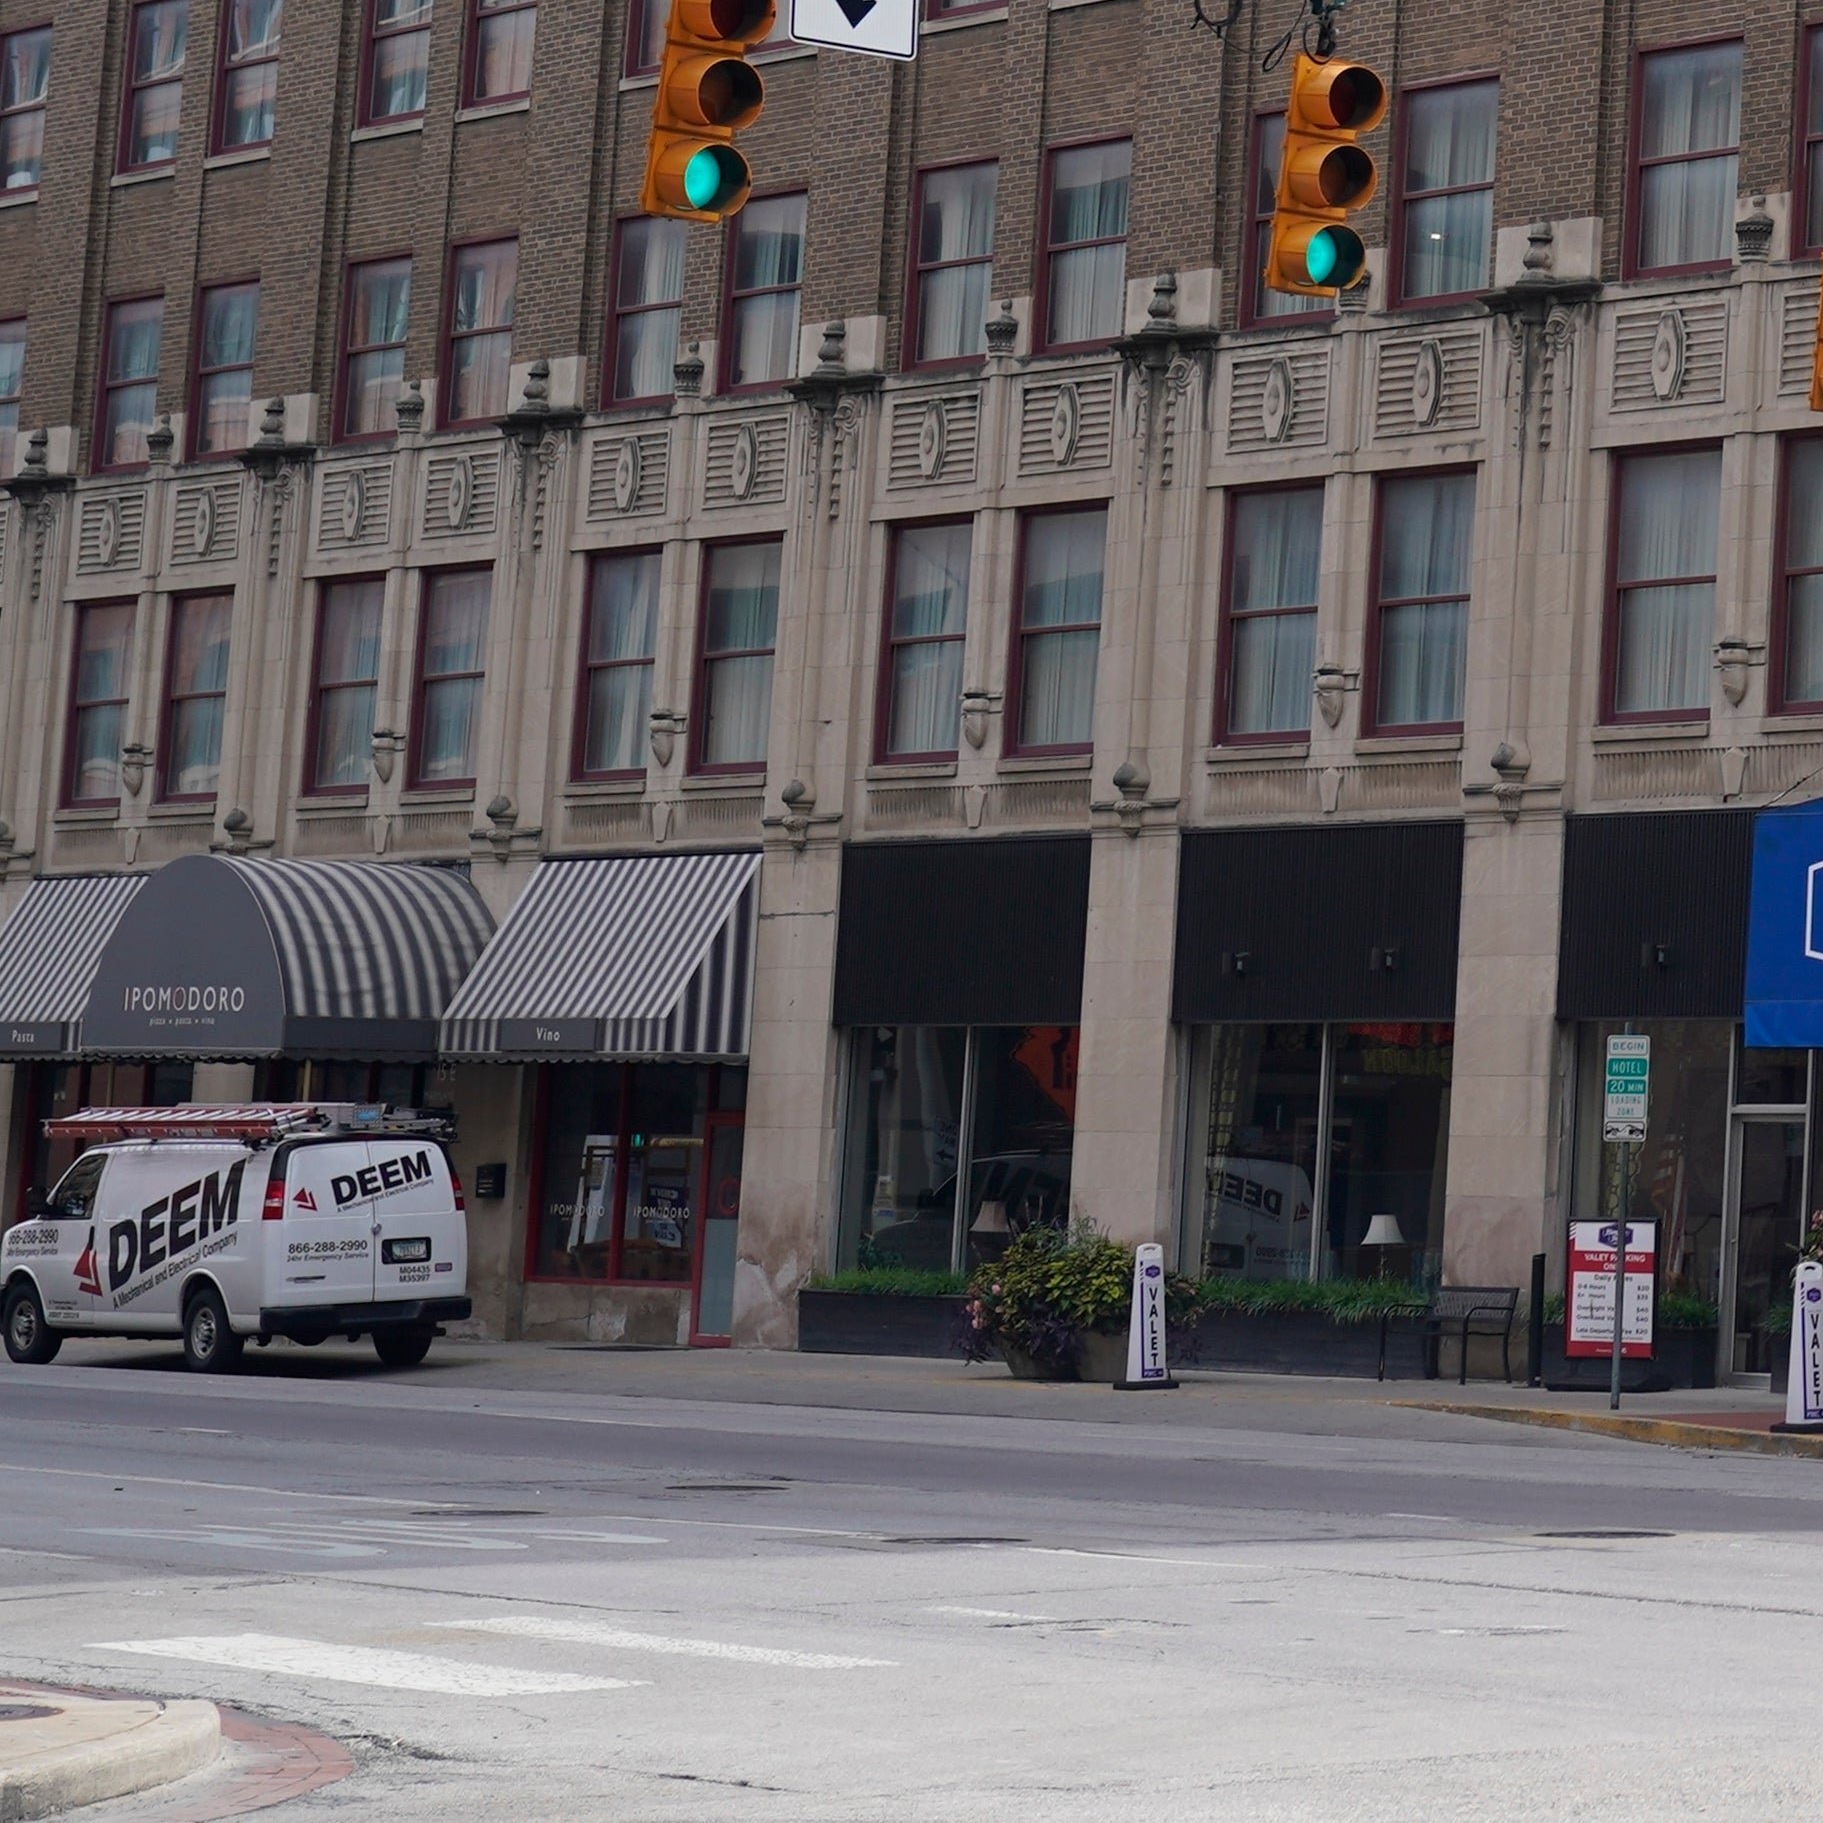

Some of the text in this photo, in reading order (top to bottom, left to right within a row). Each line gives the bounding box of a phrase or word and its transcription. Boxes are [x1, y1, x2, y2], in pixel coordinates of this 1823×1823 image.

[123, 986, 245, 1012] IPOMODORO
[12, 1029, 35, 1044] Pasta
[536, 1027, 561, 1042] Vino
[1612, 1041, 1645, 1051] BEGIN
[1612, 1060, 1642, 1074] HOTEL
[1610, 1080, 1644, 1093] 20 MIN
[1611, 1095, 1641, 1105] LOADING
[1616, 1107, 1634, 1116] ZONE
[330, 1150, 432, 1206] DEEM
[108, 1158, 247, 1292] DEEM
[288, 1240, 368, 1254] 866-288-2990
[303, 1253, 342, 1263] Emergency
[344, 1252, 369, 1261] Service
[1584, 1252, 1646, 1263] VALET PAKING
[118, 1279, 153, 1308] Mechanical
[155, 1271, 169, 1286] and
[168, 1251, 201, 1278] Electrical
[203, 1230, 238, 1258] Company
[1148, 1287, 1159, 1367] VALET
[1810, 1313, 1821, 1407] VALET
